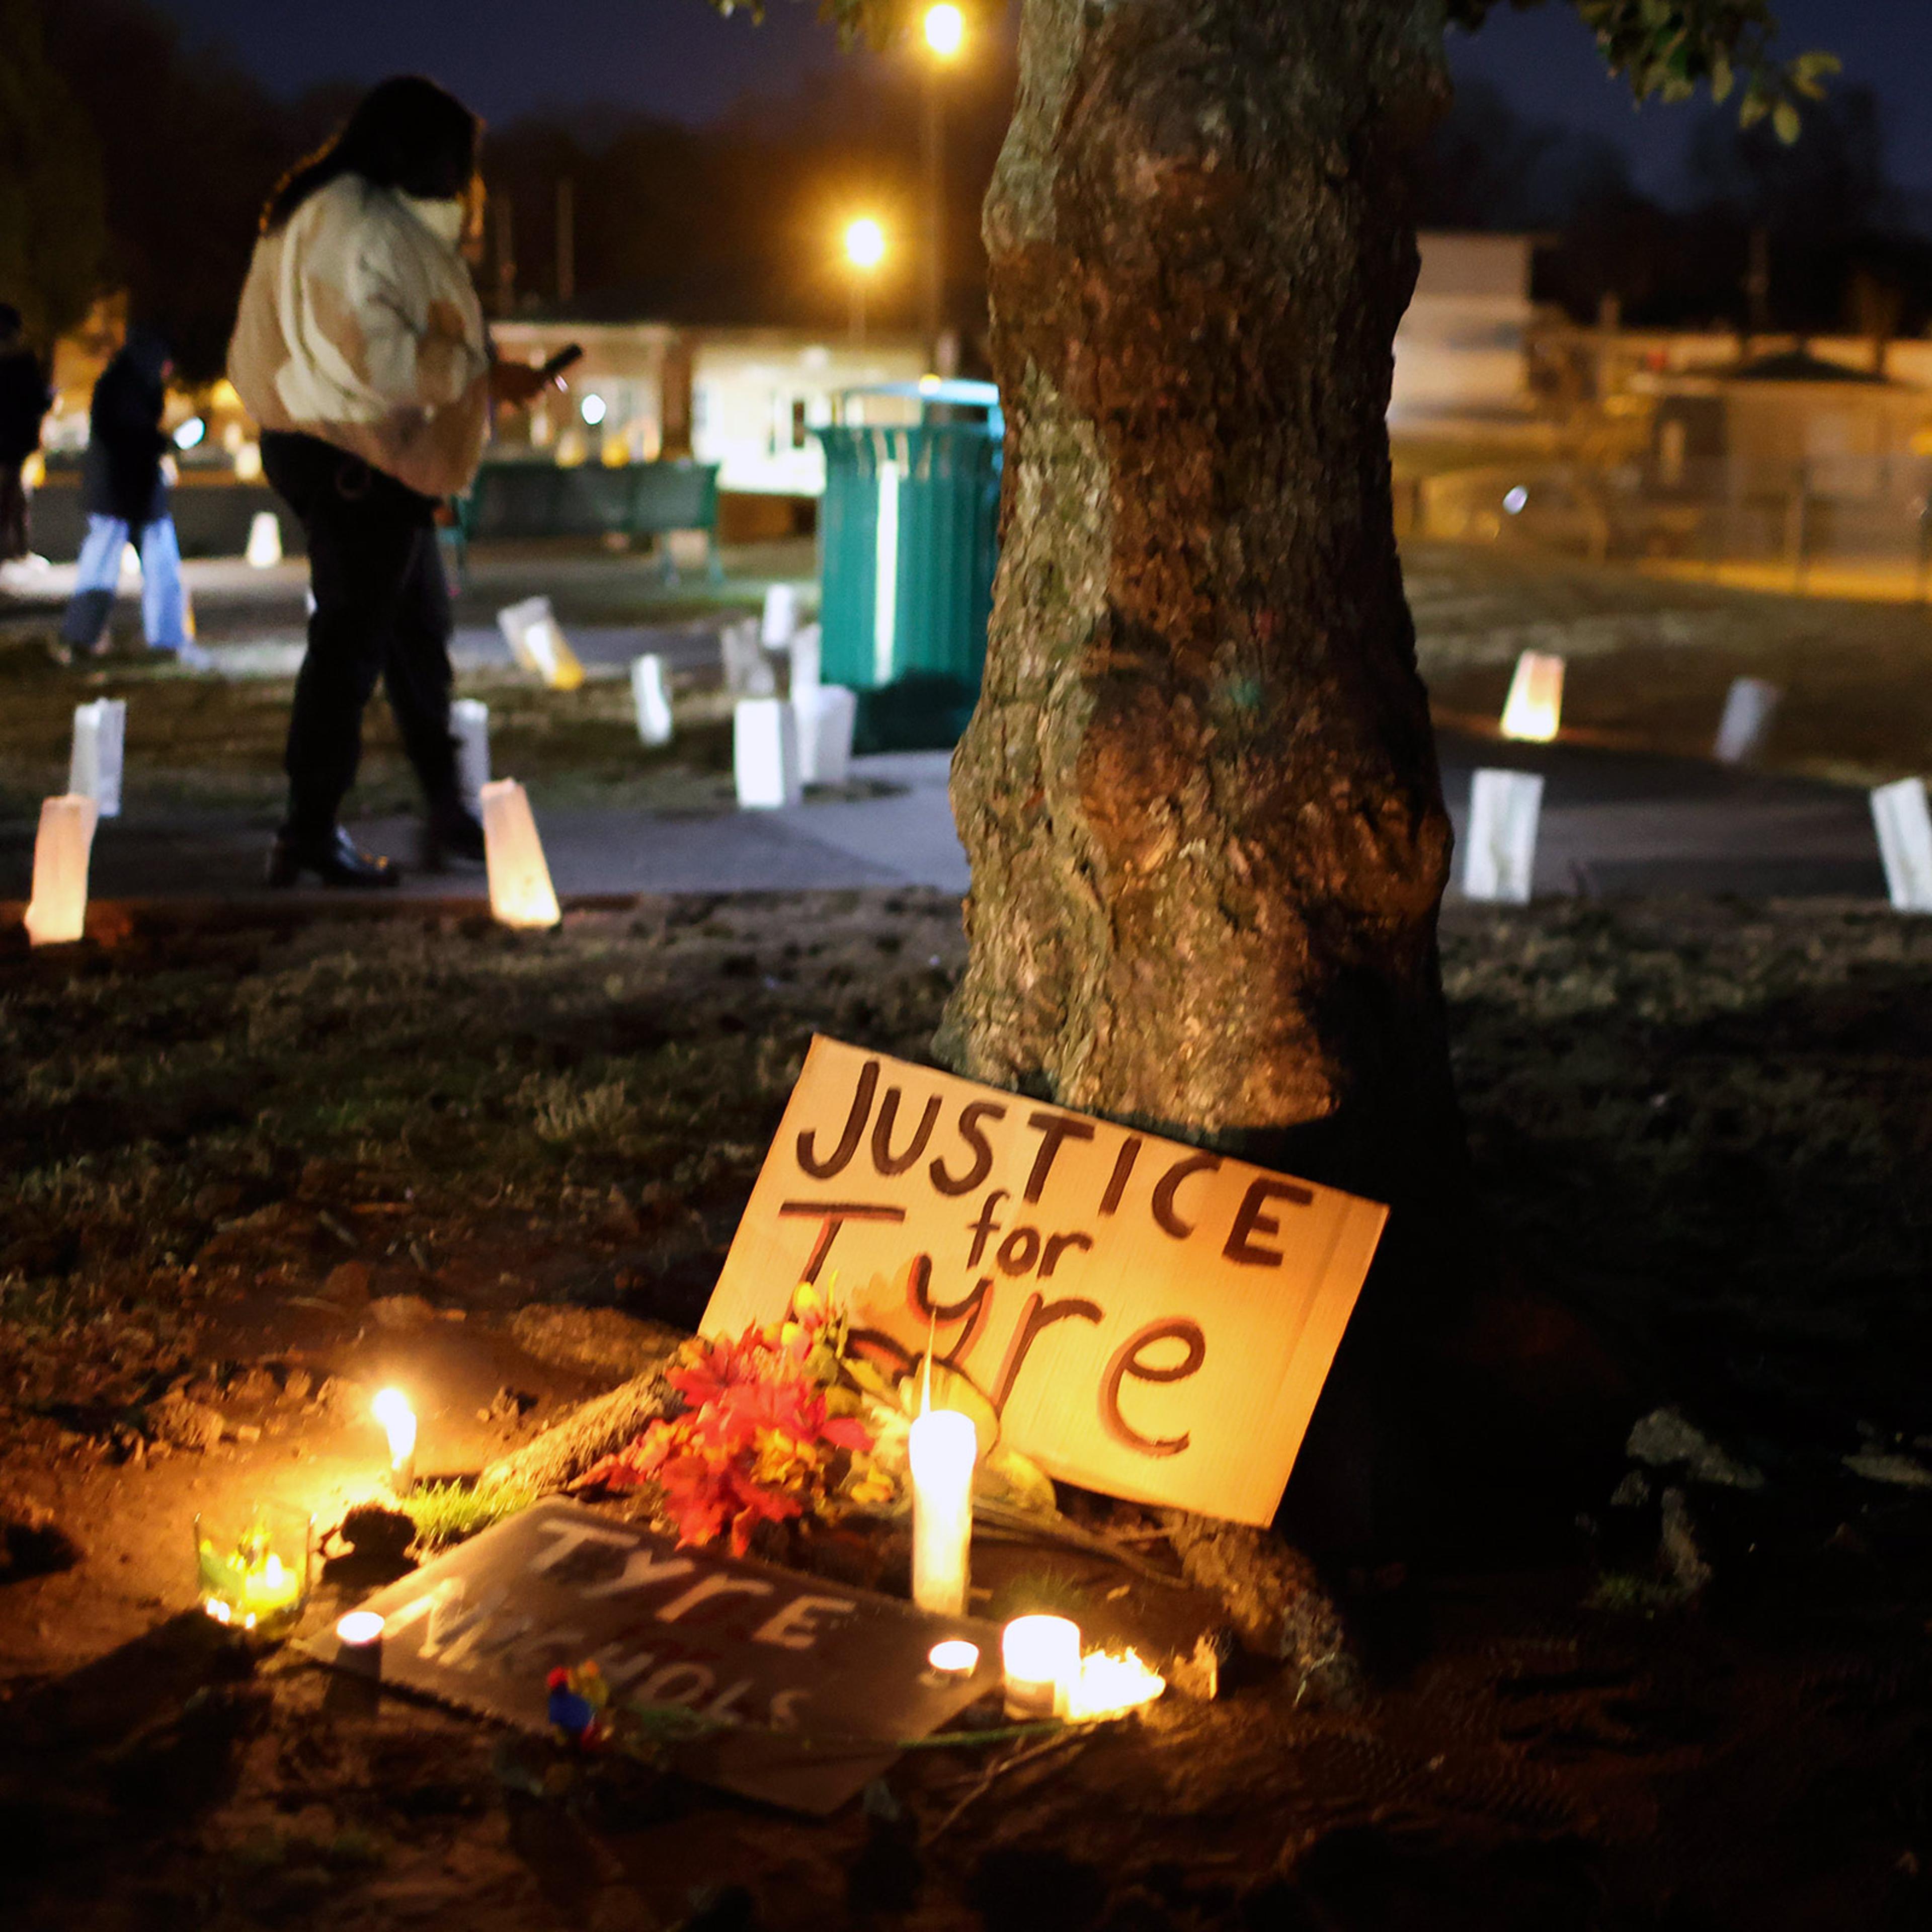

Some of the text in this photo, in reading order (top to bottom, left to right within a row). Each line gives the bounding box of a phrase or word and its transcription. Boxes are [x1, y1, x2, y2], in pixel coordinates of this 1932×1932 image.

[796, 1060, 1314, 1267] JUSTICE
[965, 1189, 1093, 1278] for
[778, 1200, 1206, 1458] Tyre
